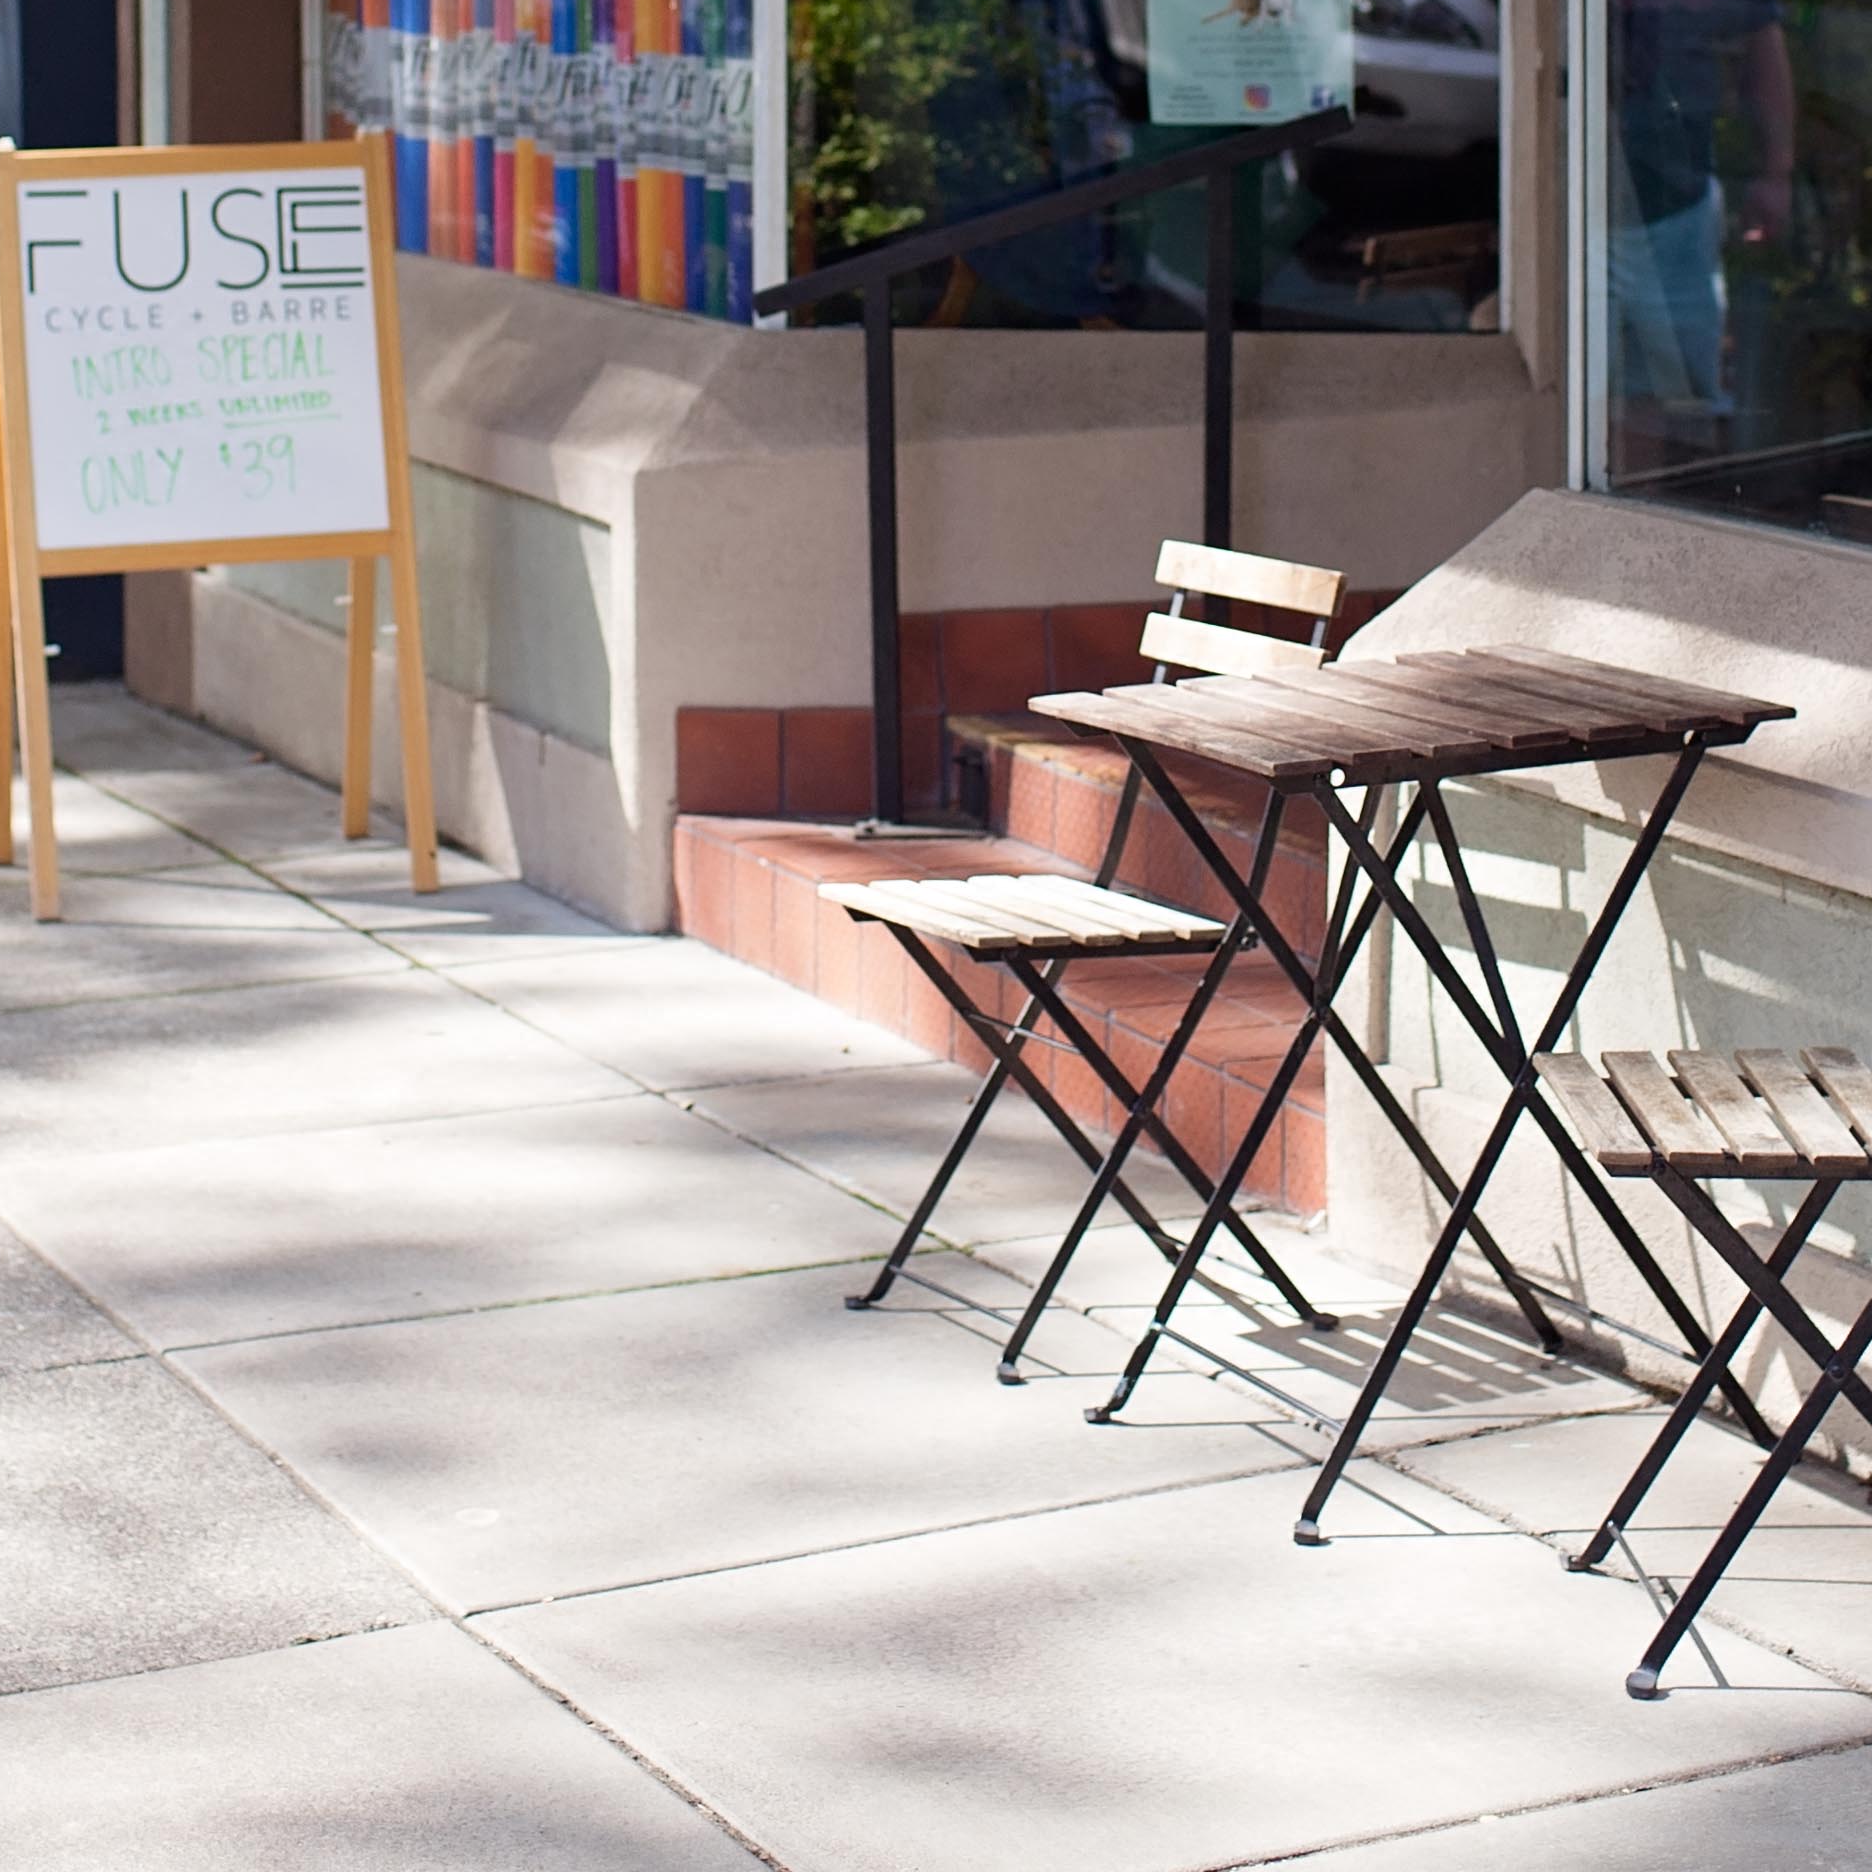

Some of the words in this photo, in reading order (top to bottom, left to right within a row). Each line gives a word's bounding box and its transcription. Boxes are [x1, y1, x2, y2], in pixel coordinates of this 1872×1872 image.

[26, 185, 366, 294] FUSE
[44, 303, 164, 334] CYCLE
[231, 295, 352, 326] BARRE
[71, 343, 173, 399] INTRO
[197, 328, 336, 384] SPECIAL
[98, 409, 112, 435] 2
[127, 399, 204, 426] WEEKS
[80, 447, 185, 516] ONLY
[218, 432, 297, 502] $39
